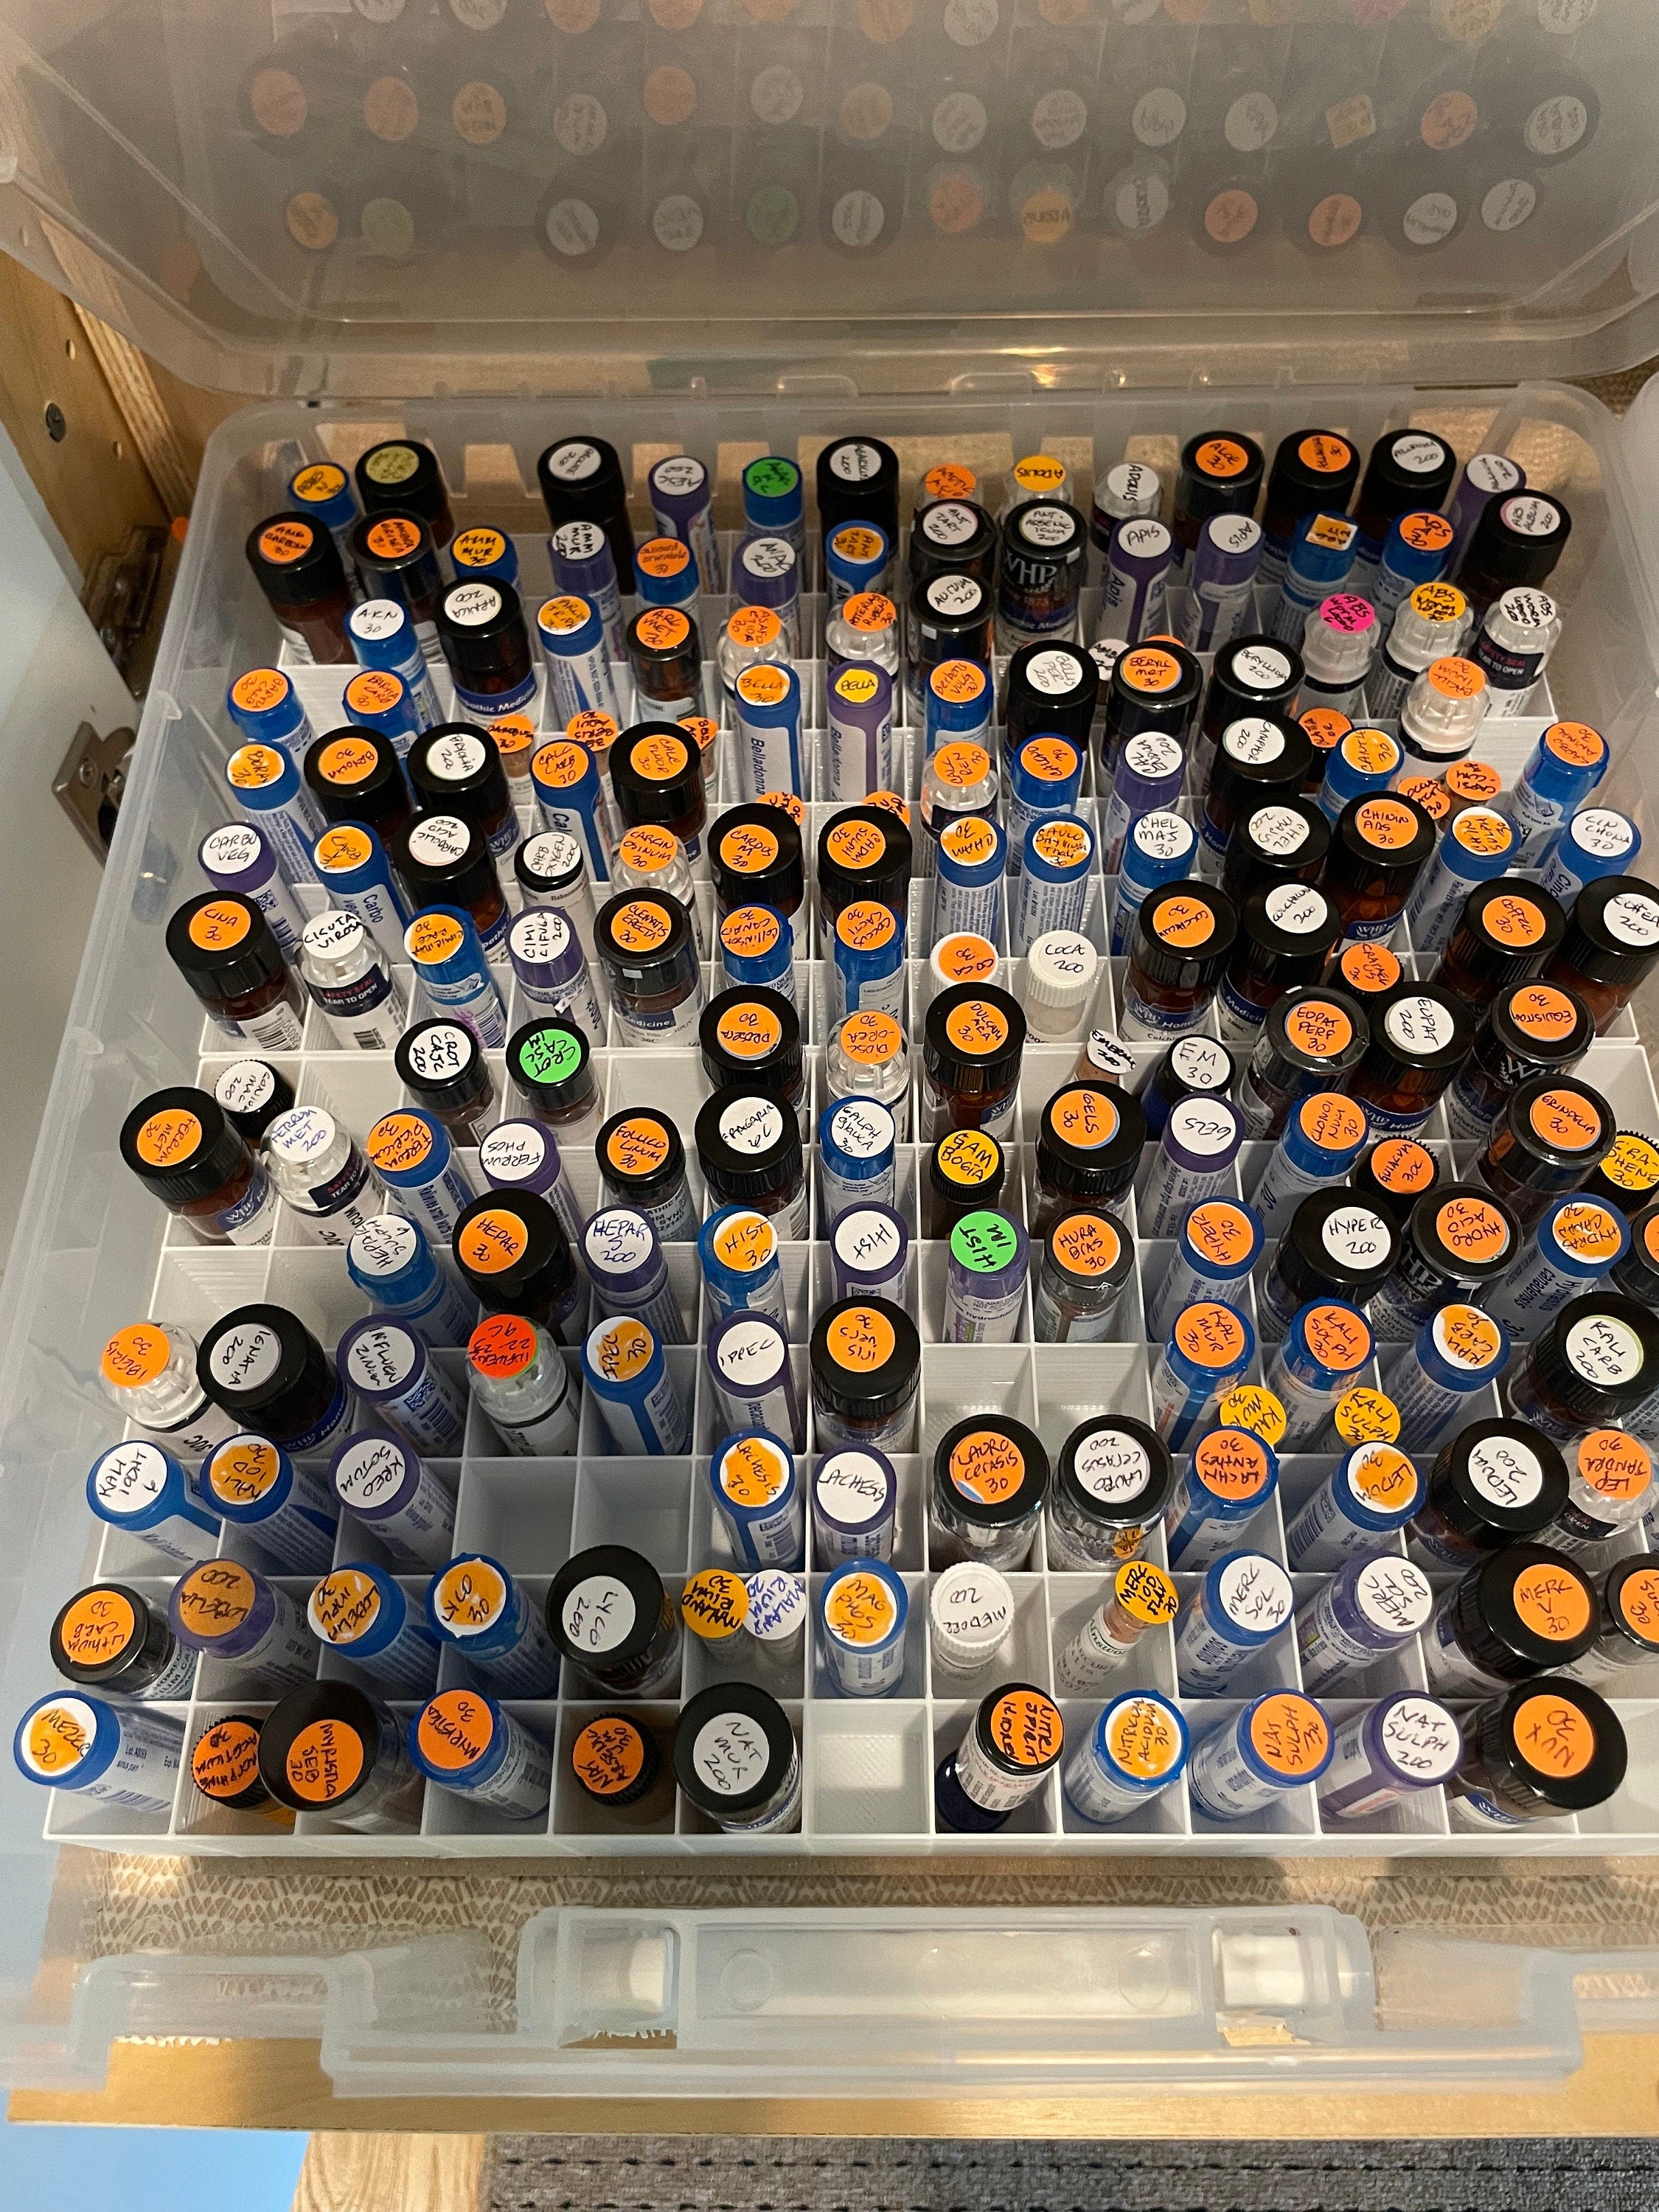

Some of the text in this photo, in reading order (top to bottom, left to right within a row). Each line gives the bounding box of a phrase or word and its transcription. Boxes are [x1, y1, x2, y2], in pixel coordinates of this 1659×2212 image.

[664, 466, 693, 474] 200
[1207, 455, 1224, 469] 30
[928, 524, 947, 539] 200
[1127, 524, 1160, 546] APIS
[1229, 521, 1253, 547] APIS
[751, 555, 777, 572] 200
[456, 591, 484, 602] 200
[645, 633, 663, 644] 30
[841, 679, 875, 691] BELLA
[1033, 669, 1050, 687] 200
[1237, 729, 1250, 748] 200
[751, 737, 766, 795] Belladonna
[956, 821, 975, 838] 30
[1141, 816, 1179, 830] CHEL
[832, 827, 850, 843] 30
[1379, 834, 1394, 844] 30
[1590, 838, 1613, 849] 30
[218, 846, 250, 862] VEG
[952, 833, 992, 857] CHAM
[1155, 844, 1174, 857] 30
[633, 855, 647, 867] 30
[364, 894, 383, 922] Carbo
[620, 930, 636, 942] 30
[1054, 959, 1084, 973] 200
[355, 983, 380, 1001] OPEN
[1399, 1010, 1414, 1039] 200
[445, 1032, 459, 1067] CROT
[413, 1047, 426, 1072] 200
[534, 1046, 575, 1078] CROT
[1188, 1067, 1212, 1085] 30
[226, 1077, 241, 1099] 200
[1063, 1110, 1079, 1127] 30
[1549, 1117, 1568, 1134] 30
[147, 1122, 161, 1138] 30
[282, 1120, 311, 1149] MET
[302, 1130, 326, 1152] 200
[488, 1141, 525, 1152] PHOS
[1447, 1203, 1468, 1217] 30
[594, 1220, 649, 1237] HEPAR
[1222, 1221, 1241, 1240] 30
[1329, 1217, 1385, 1236] HYPER
[476, 1217, 519, 1256] HEPAR
[726, 1220, 771, 1253] HIST
[473, 1244, 490, 1261] 30
[959, 1227, 996, 1267] HIST
[1346, 1241, 1377, 1254] 200
[600, 1251, 636, 1263] 200
[745, 1248, 771, 1266] 30
[1085, 1256, 1105, 1269] 30
[133, 1336, 152, 1355] 30
[627, 1338, 646, 1361] 30
[1183, 1329, 1199, 1352] 30
[223, 1336, 243, 1364] 200
[1575, 1351, 1599, 1379] 200
[1090, 1437, 1119, 1450] 200
[1599, 1437, 1622, 1450] 30
[1363, 1450, 1382, 1470] 30
[1497, 1450, 1527, 1483] 200
[1401, 1569, 1427, 1599] 200
[1520, 1579, 1573, 1603] MERC
[91, 1601, 113, 1617] 30
[467, 1598, 489, 1622] 30
[1245, 1587, 1274, 1620] SOL
[1266, 1599, 1285, 1623] 30
[1546, 1617, 1570, 1634] 30
[1395, 1705, 1447, 1731] NAT
[1547, 1711, 1576, 1741] 30
[1526, 1723, 1574, 1768] NUX
[1397, 1750, 1433, 1770] 200
[703, 1755, 731, 1790] 200
